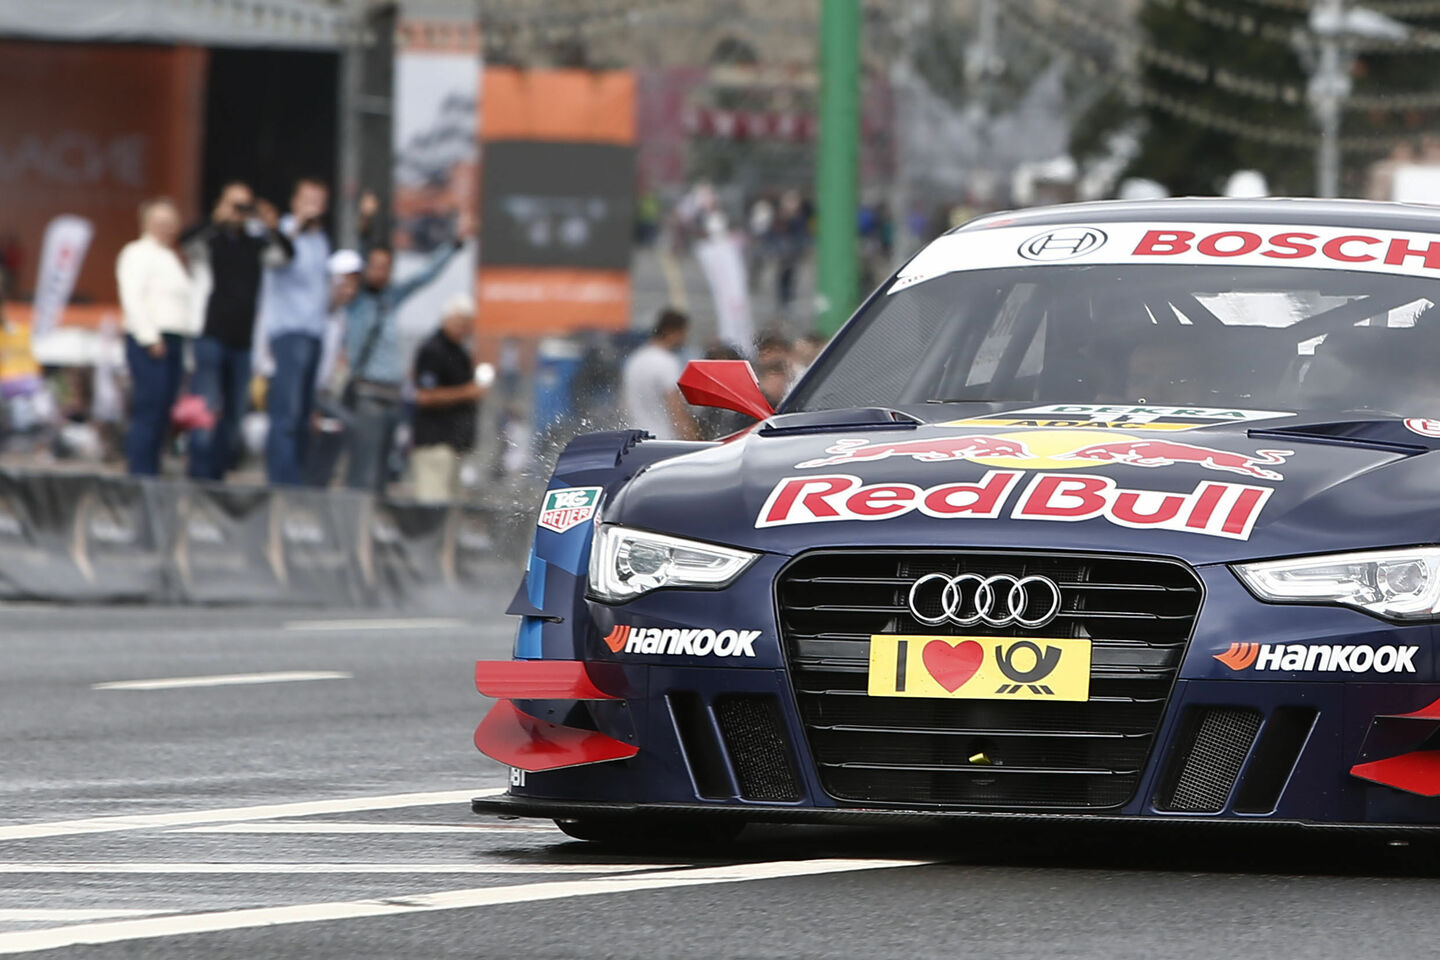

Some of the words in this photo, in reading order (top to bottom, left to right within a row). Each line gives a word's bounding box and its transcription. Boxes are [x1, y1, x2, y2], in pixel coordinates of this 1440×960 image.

[1050, 406, 1247, 418] DEKRA
[1007, 420, 1146, 429] ADAC
[554, 490, 590, 509] TAG
[757, 470, 1025, 527] Red
[1011, 473, 1272, 539] Bull
[542, 507, 592, 529] HEUER
